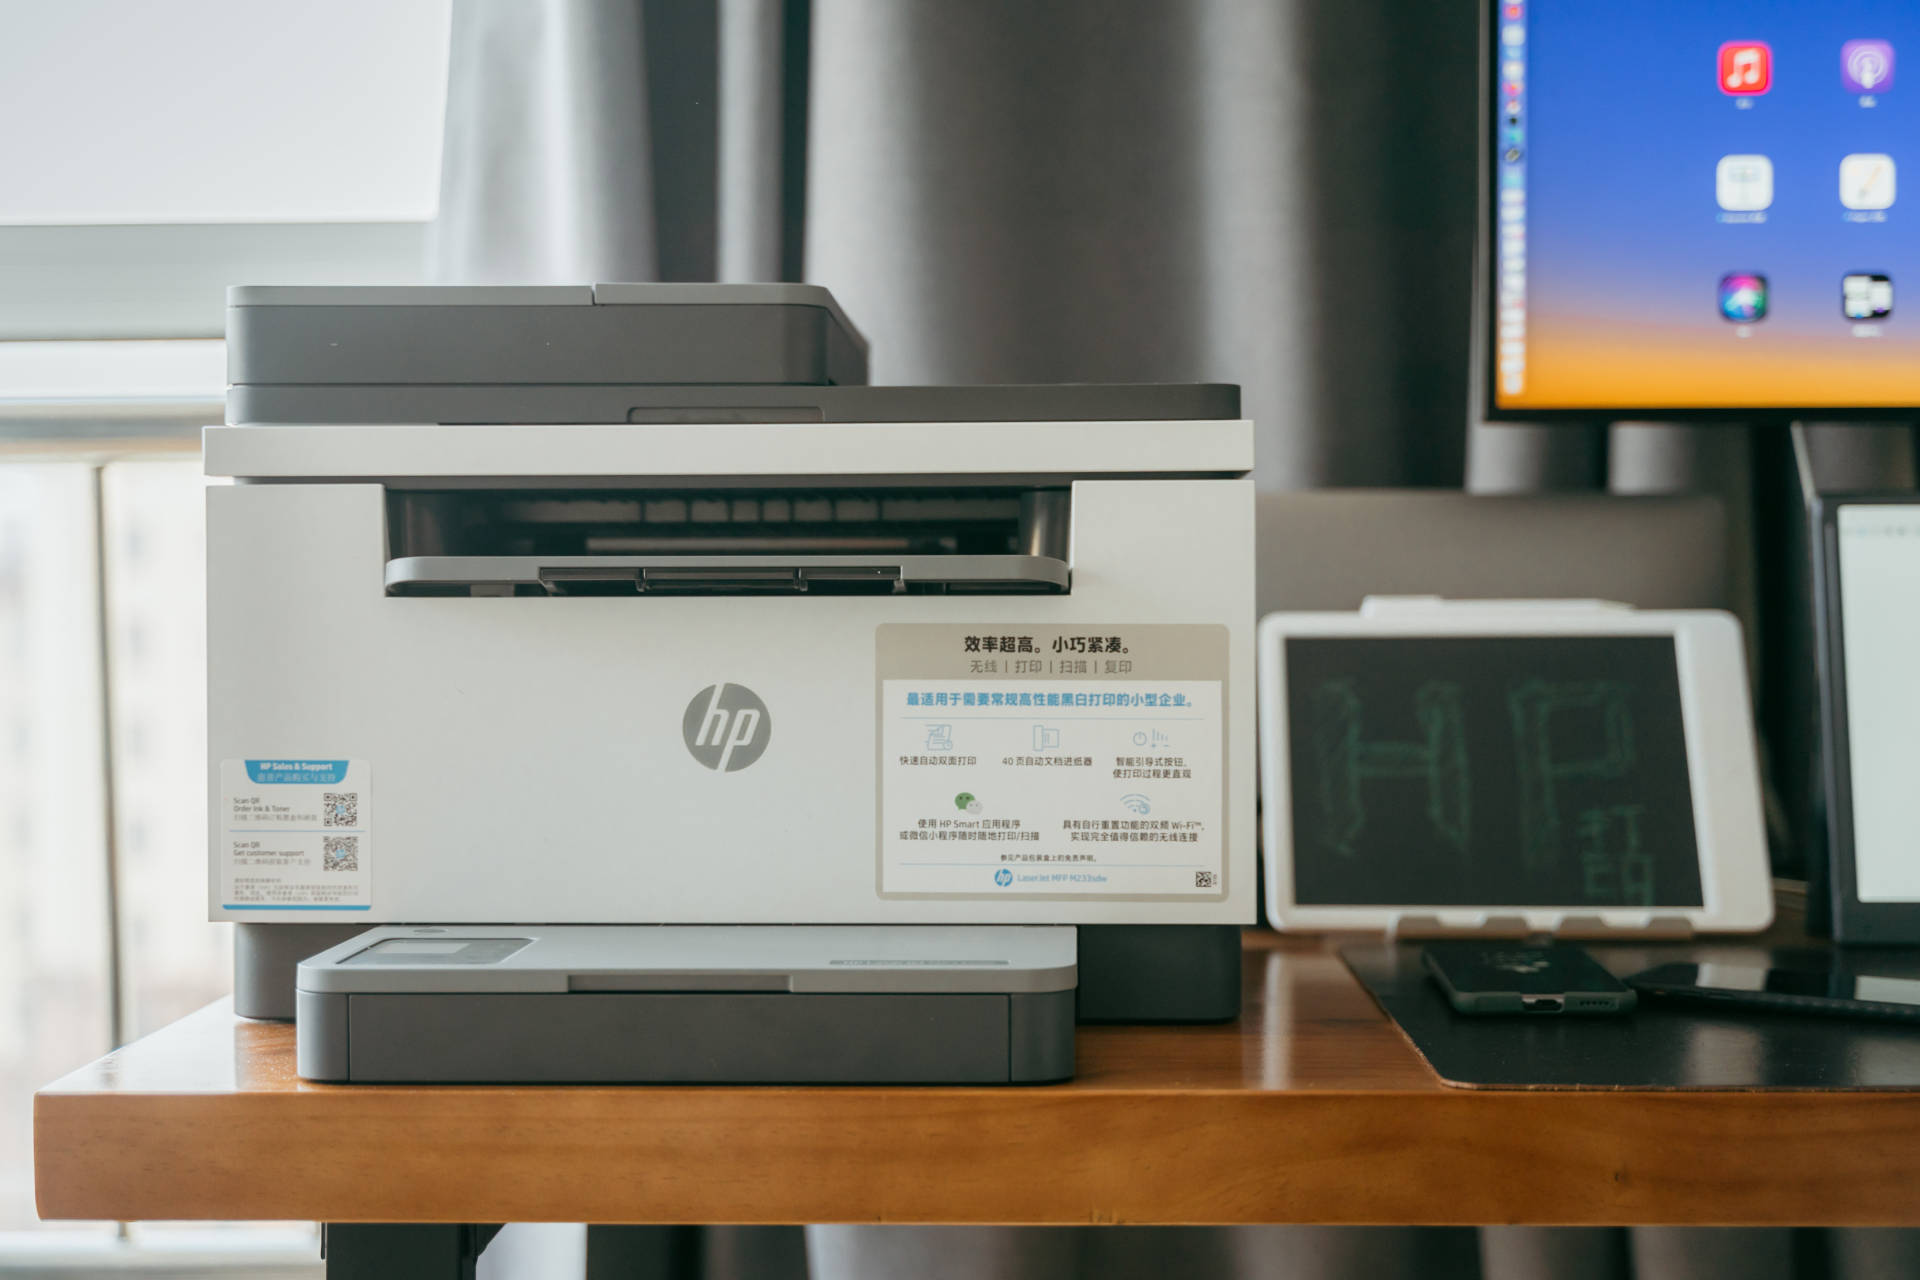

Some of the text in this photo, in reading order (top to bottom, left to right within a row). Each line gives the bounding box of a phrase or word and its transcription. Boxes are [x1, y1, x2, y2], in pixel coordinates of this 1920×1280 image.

[964, 635, 1132, 654] 效率超高。小巧紧凑。
[969, 660, 1132, 674] 无线 打印 扫描 复印
[906, 692, 1192, 707] 最适用于需要常规高性能黑白打印的小型企业。
[685, 682, 769, 772] hp
[899, 756, 976, 766] 快速自动双面打印
[1016, 756, 1092, 767] 页自动文档进纸器
[302, 763, 332, 772] Support
[1112, 768, 1191, 779] 使打印过程更直观
[1313, 677, 1636, 870] HP
[917, 819, 937, 829] 使用
[953, 819, 980, 829] Smart
[982, 819, 1021, 829] 应用程序
[1062, 819, 1169, 830] 具有自行重置功能的双频
[994, 869, 1013, 887] hp
